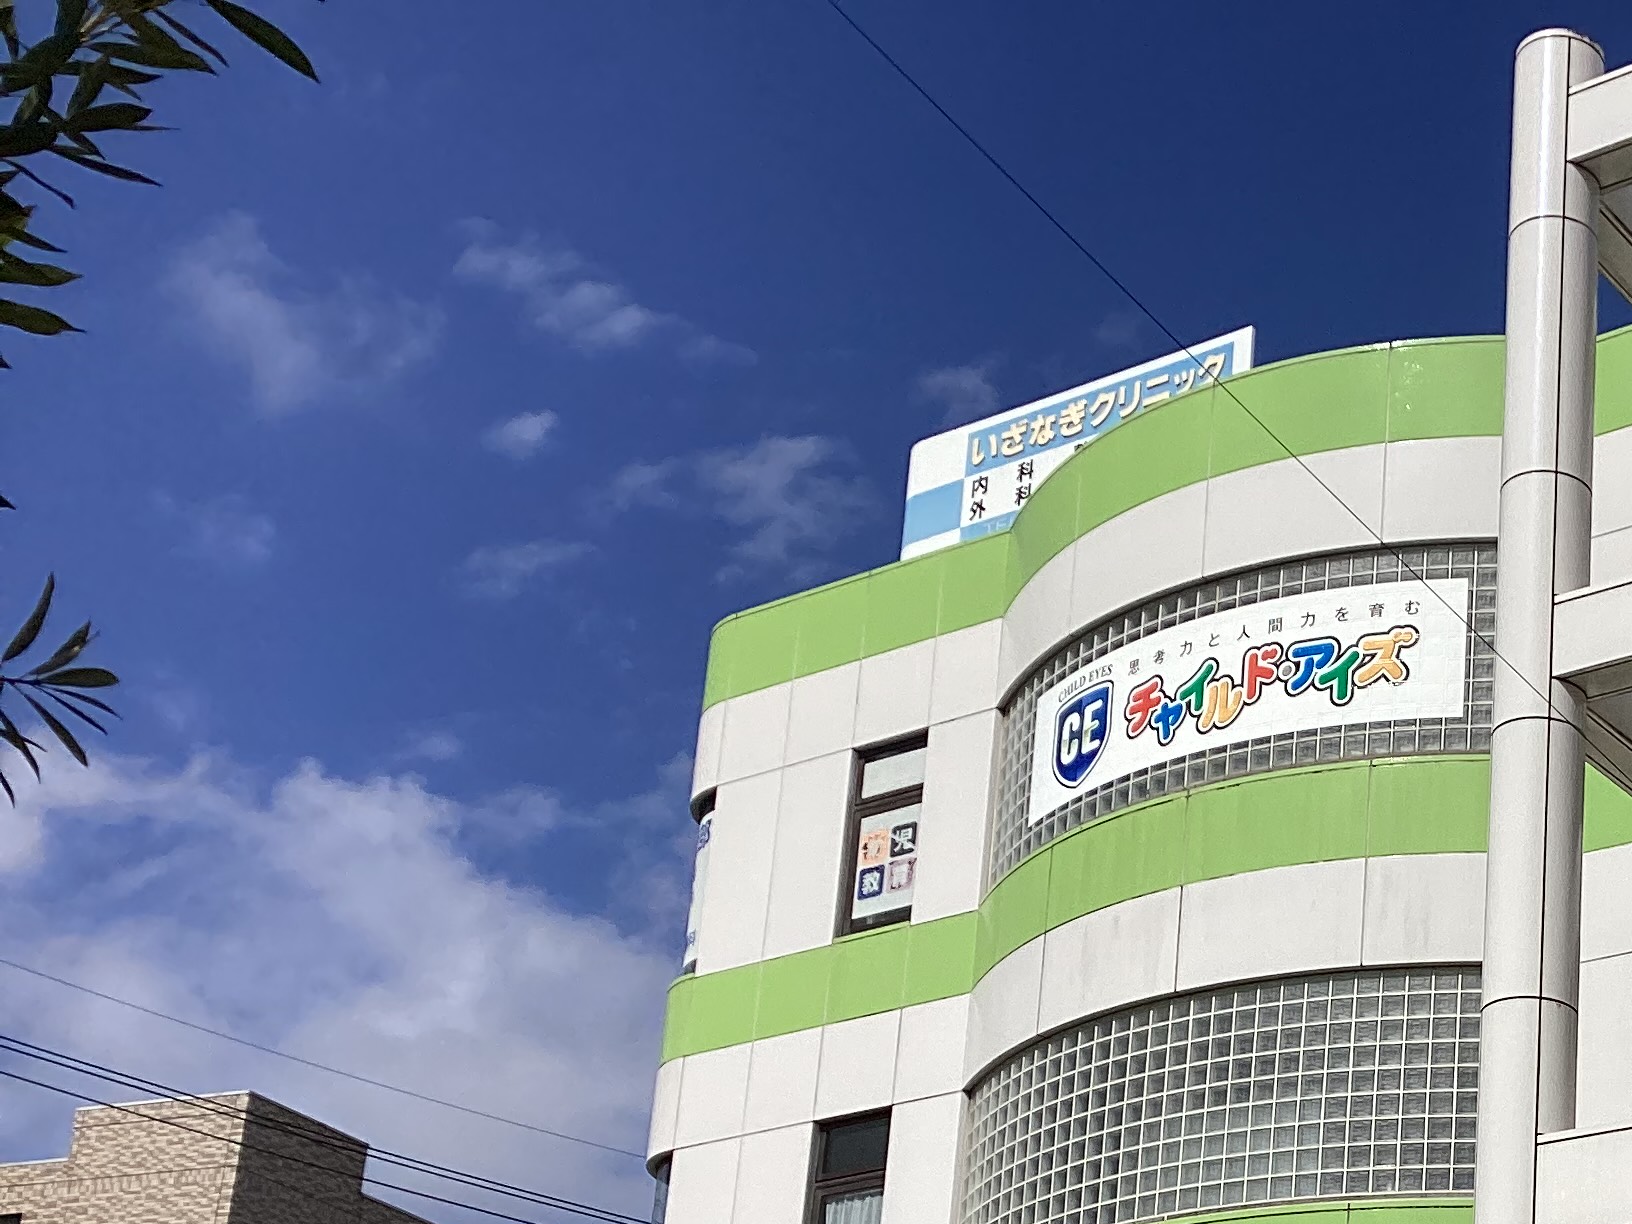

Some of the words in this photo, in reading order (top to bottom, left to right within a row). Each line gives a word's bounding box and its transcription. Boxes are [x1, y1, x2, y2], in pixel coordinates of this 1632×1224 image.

[971, 352, 1227, 466] いざなぎクリニック
[1127, 600, 1421, 676] 思考力と人間力を育む
[1058, 675, 1087, 703] CHILD
[1088, 664, 1113, 682] EYES
[1060, 698, 1104, 765] CE
